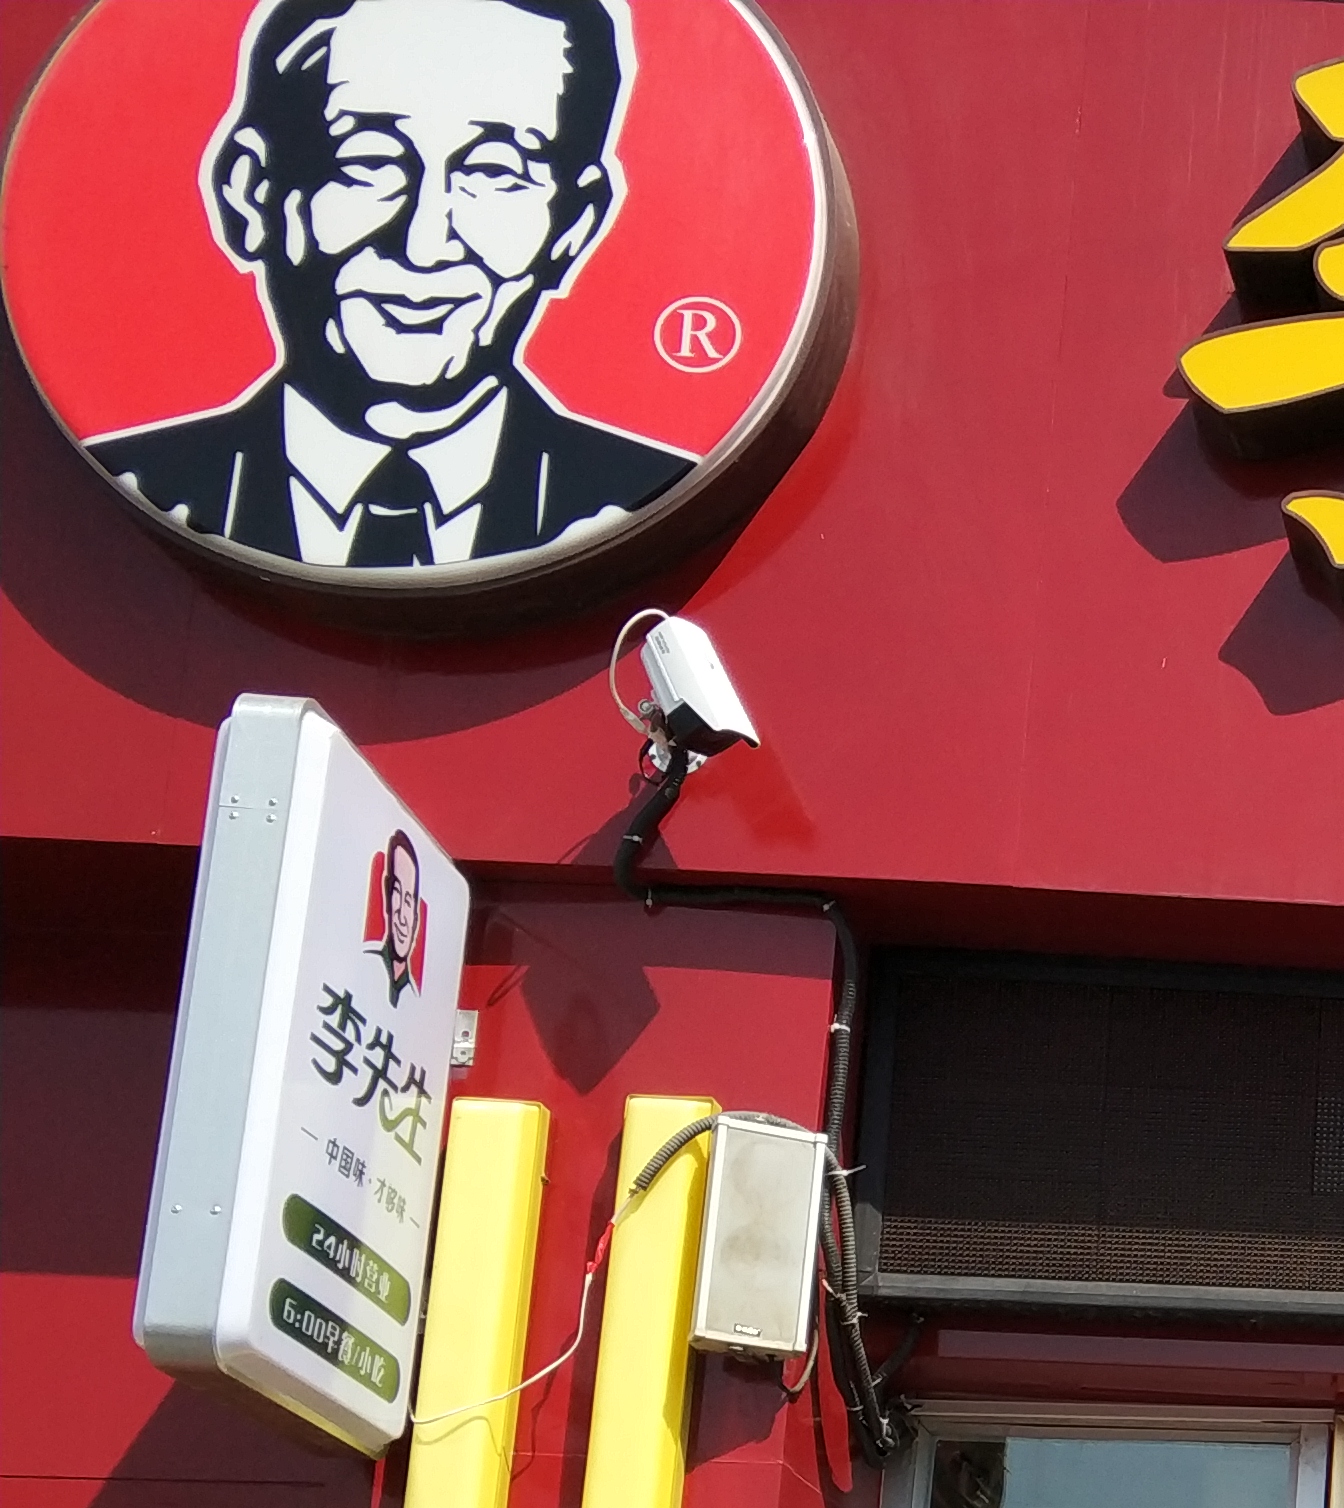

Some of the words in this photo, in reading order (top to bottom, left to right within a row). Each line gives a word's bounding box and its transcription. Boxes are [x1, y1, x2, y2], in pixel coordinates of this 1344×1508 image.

[309, 982, 433, 1167] 李先生
[311, 1223, 392, 1304] 24小时营业
[282, 1297, 386, 1389] 6:00早餐/小吃
